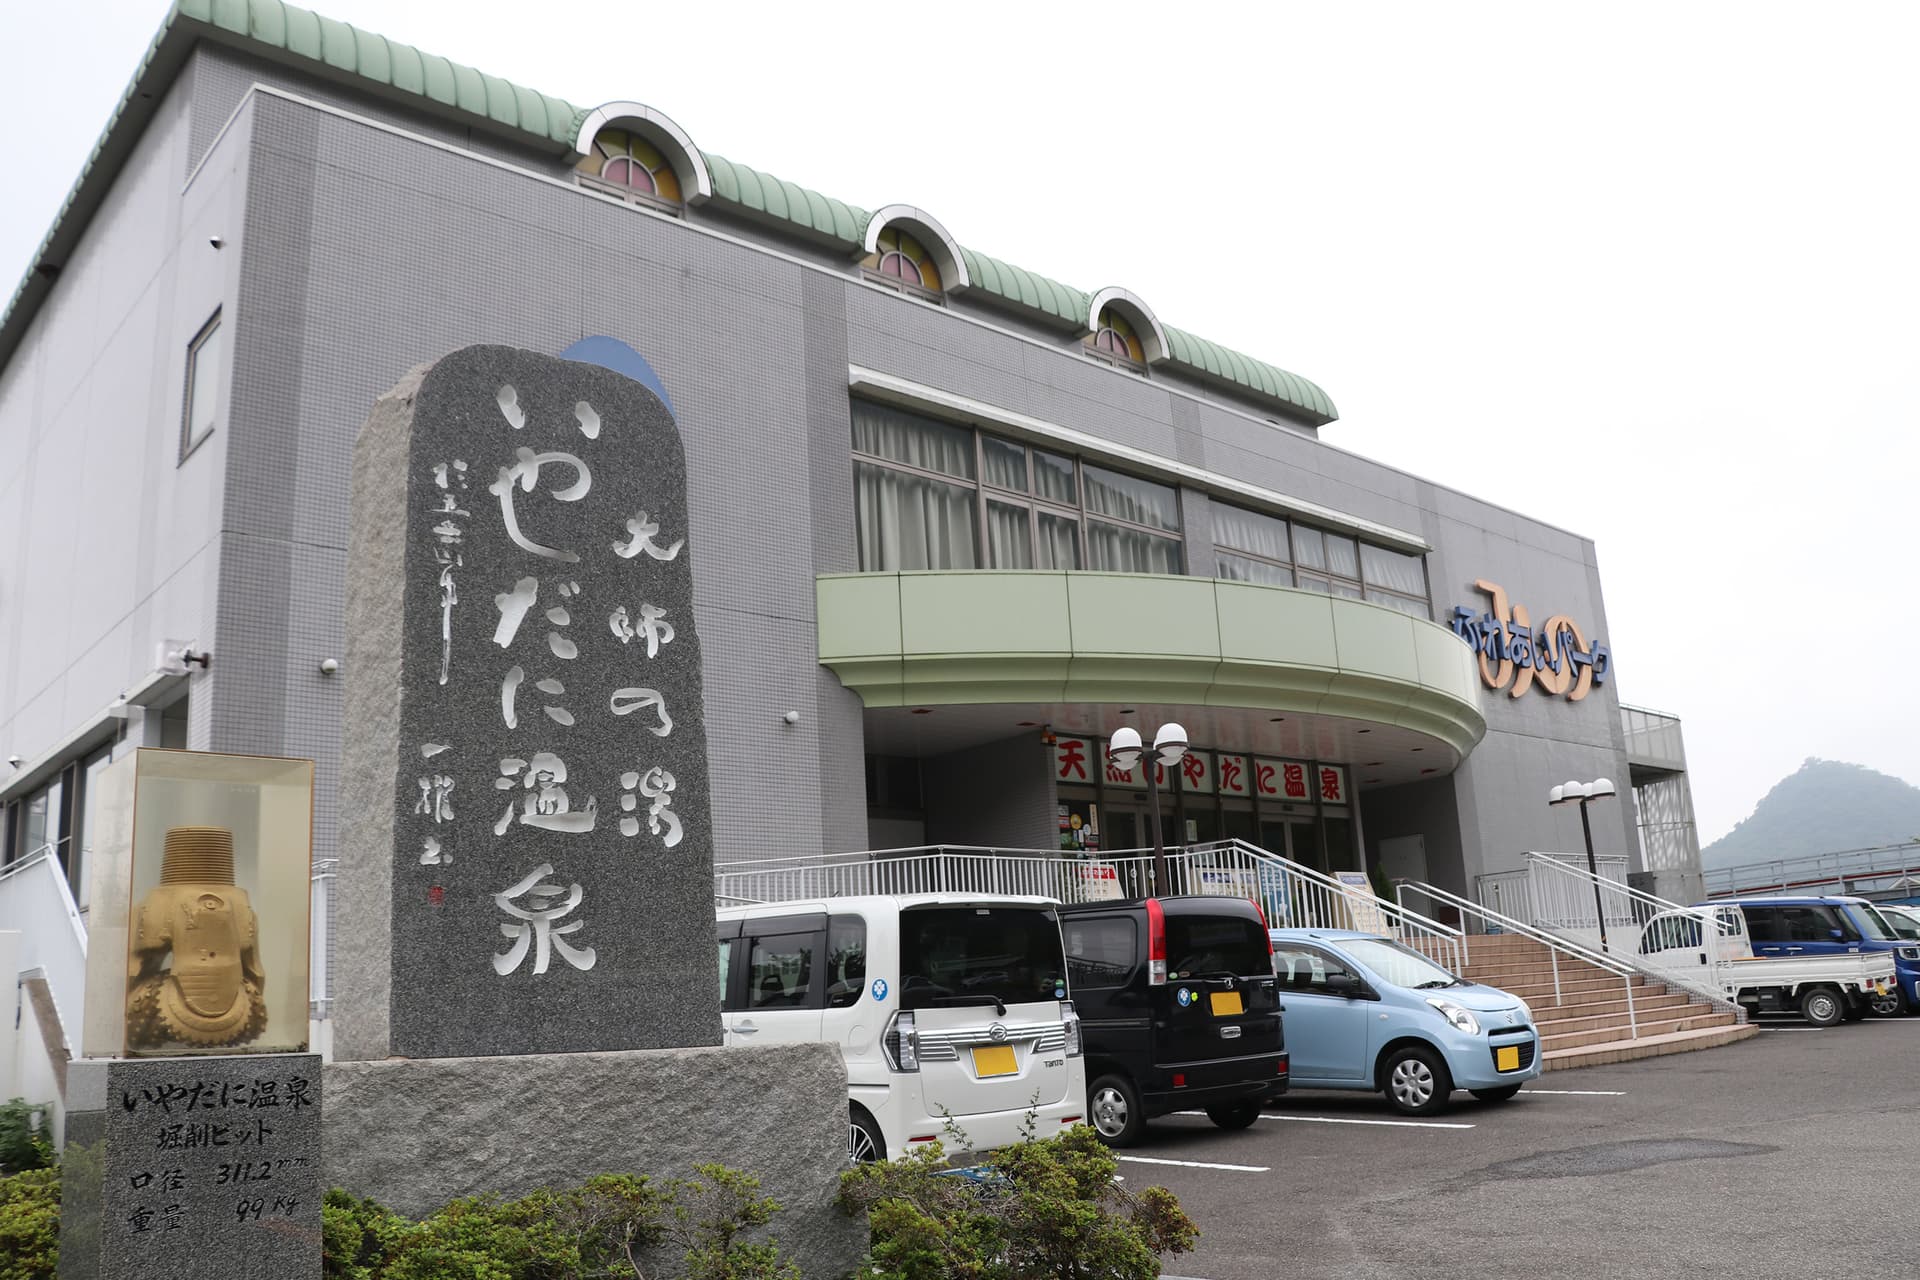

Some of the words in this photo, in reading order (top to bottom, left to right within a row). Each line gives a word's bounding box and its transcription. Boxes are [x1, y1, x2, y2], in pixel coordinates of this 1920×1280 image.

[1453, 605, 1610, 684] ふれあいパーク
[122, 1076, 313, 1113] いやだに温泉
